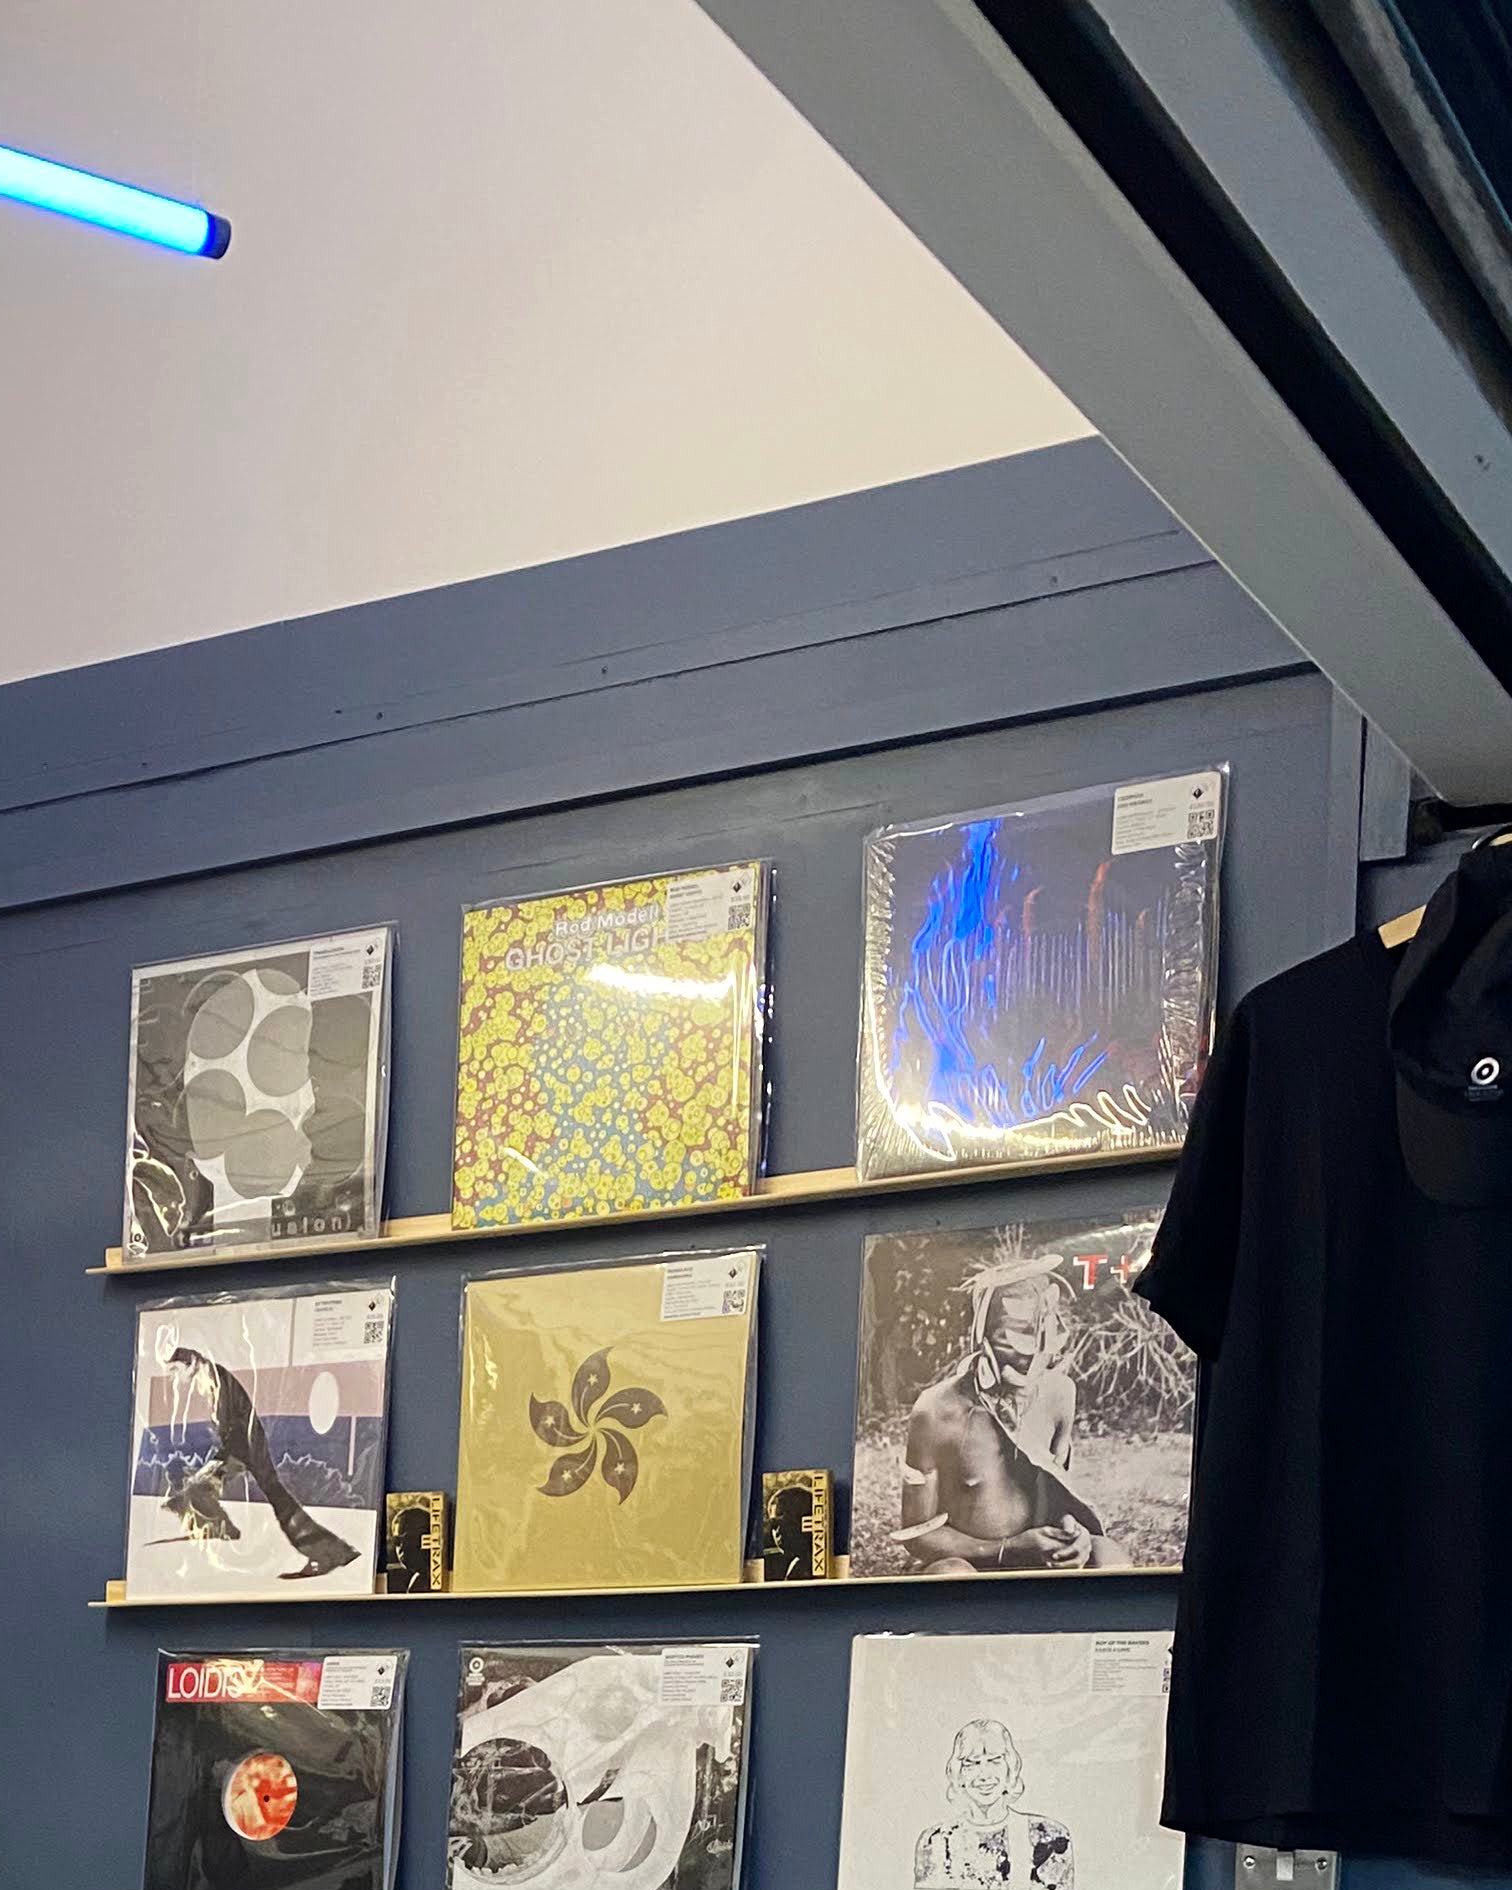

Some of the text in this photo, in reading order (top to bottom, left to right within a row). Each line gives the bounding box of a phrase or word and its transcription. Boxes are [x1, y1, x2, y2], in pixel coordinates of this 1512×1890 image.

[555, 903, 661, 937] Rod Modell
[506, 926, 669, 971] GHOST LIGH
